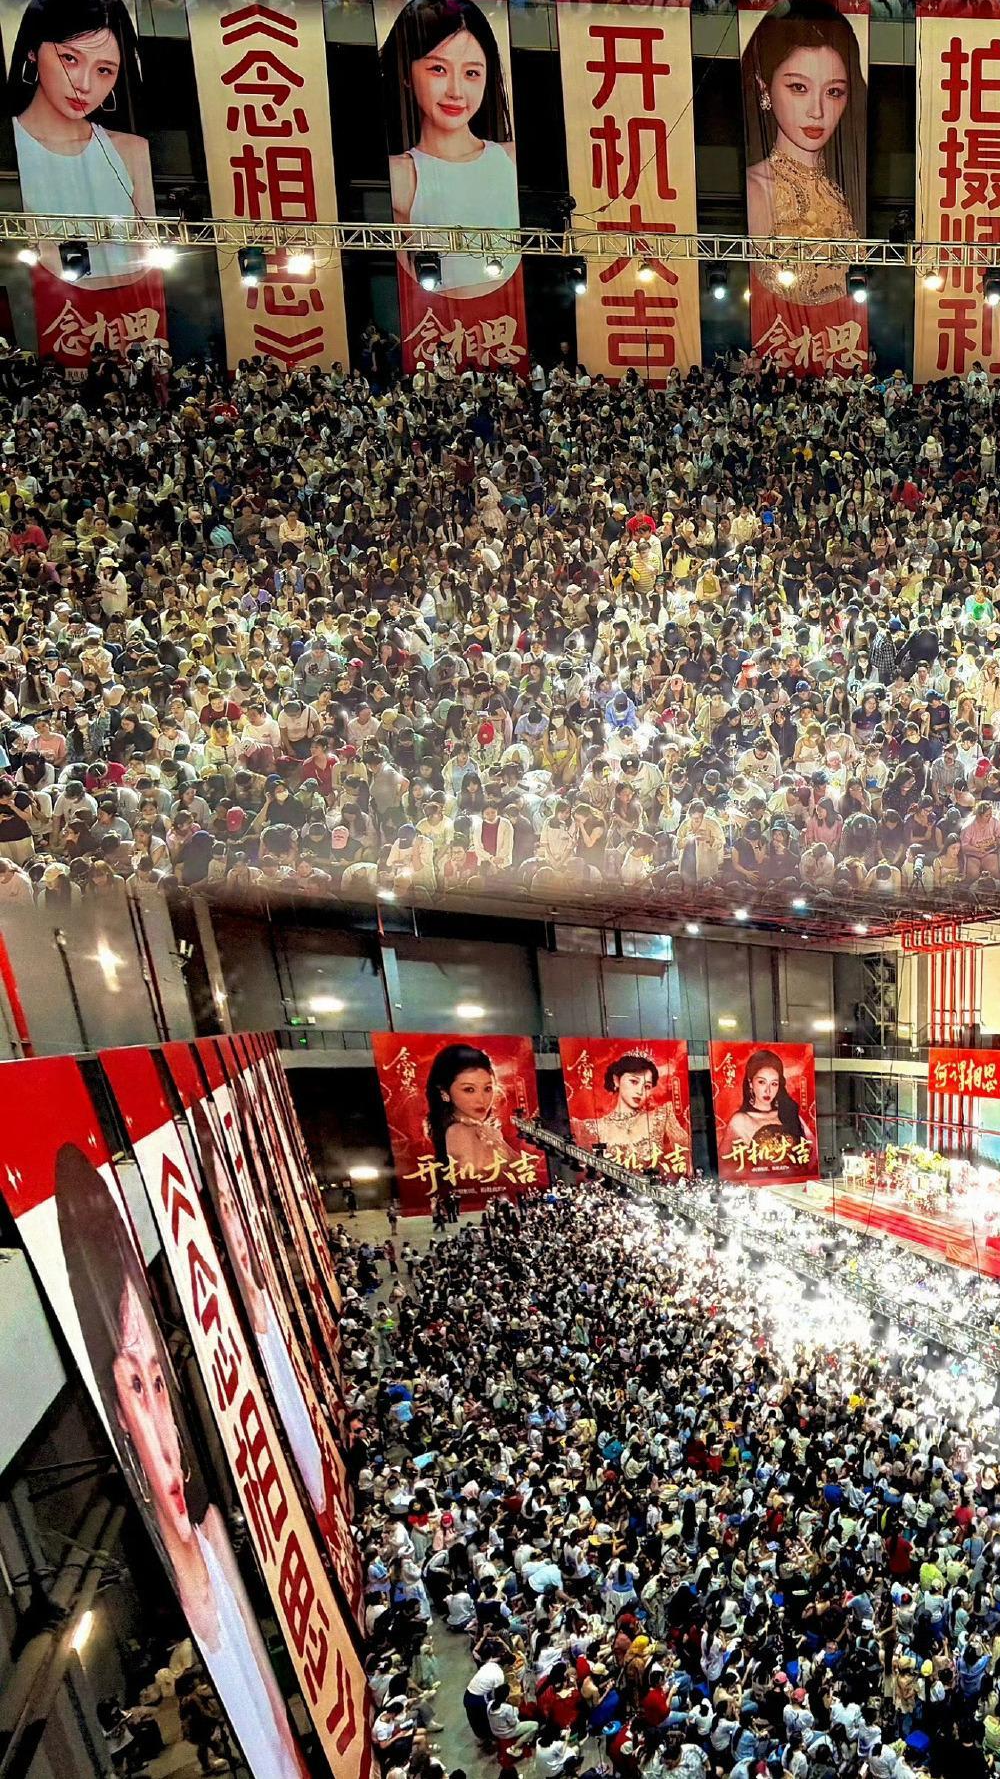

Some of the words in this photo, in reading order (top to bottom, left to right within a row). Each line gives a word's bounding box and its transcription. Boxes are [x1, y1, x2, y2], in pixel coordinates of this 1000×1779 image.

[585, 25, 679, 367] 开机大吉
[404, 307, 526, 367] 念相思
[402, 1150, 540, 1196] 开机大吉
[603, 1144, 690, 1174] 机大吉
[722, 1135, 813, 1173] 开机大吉
